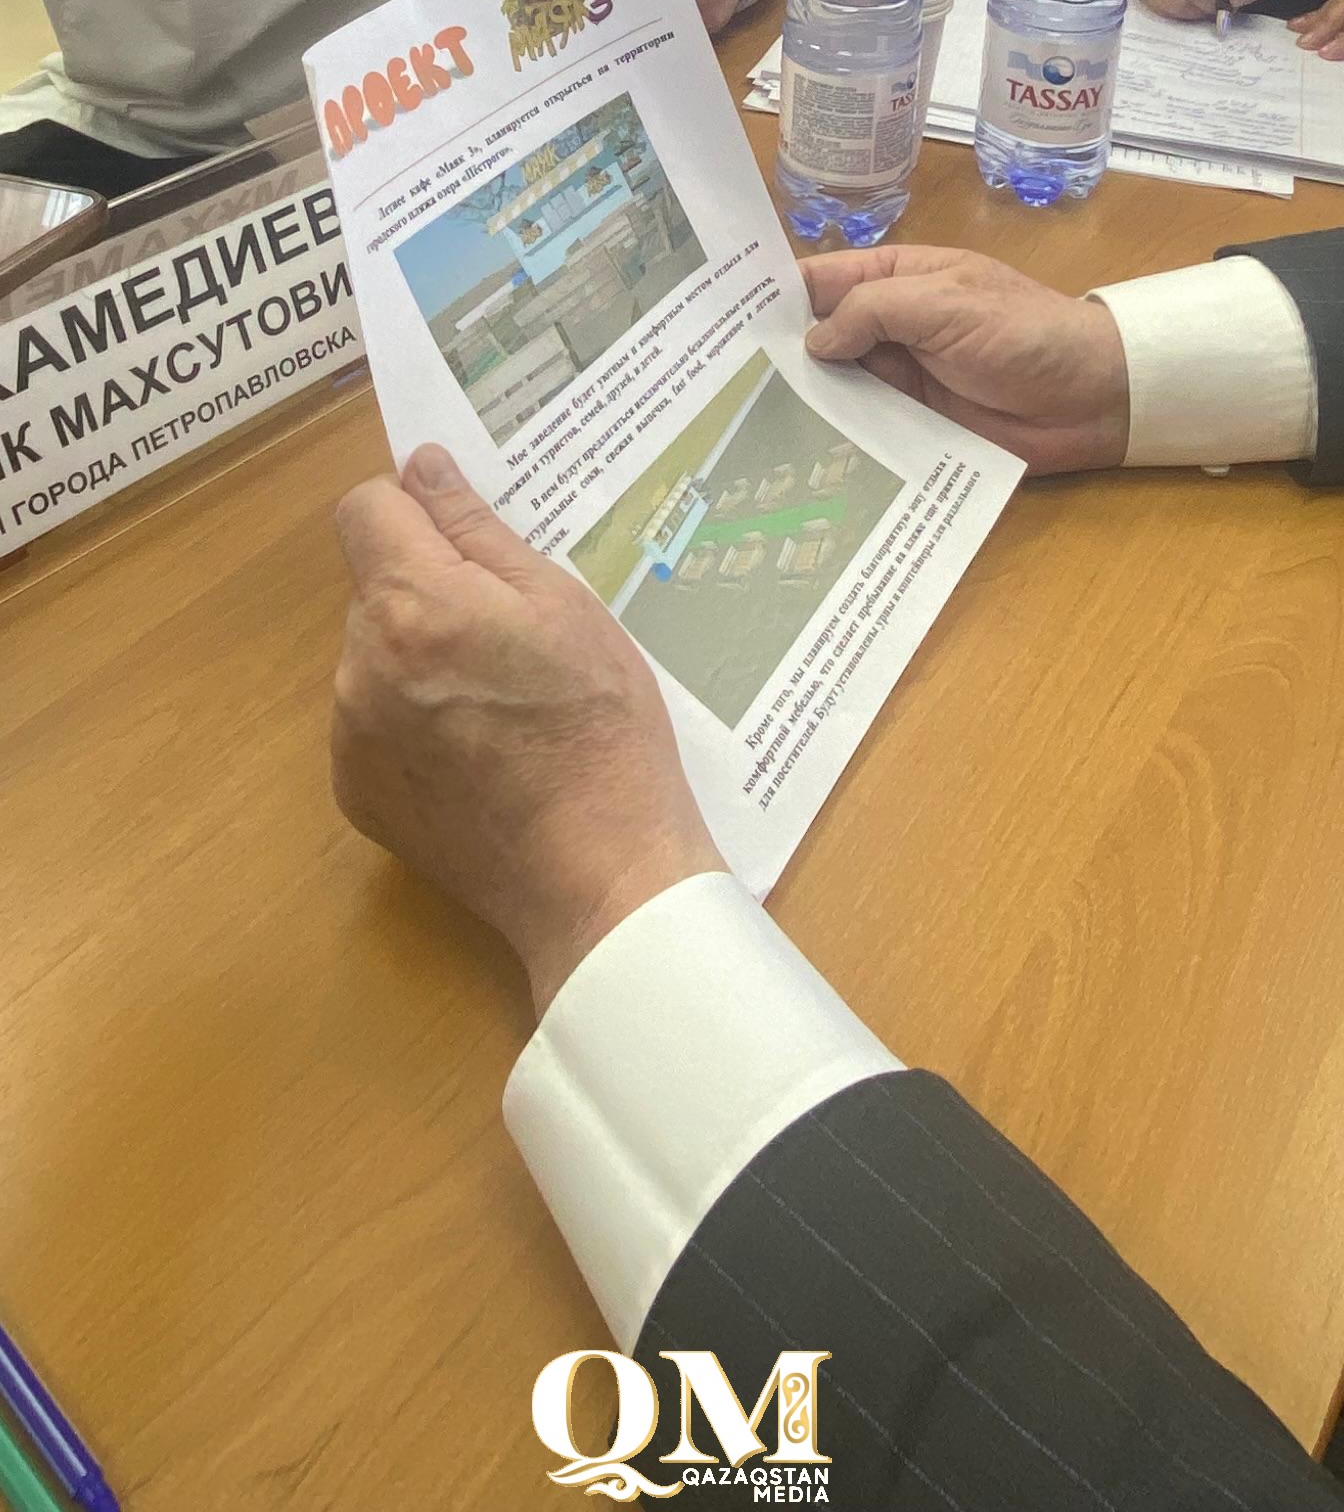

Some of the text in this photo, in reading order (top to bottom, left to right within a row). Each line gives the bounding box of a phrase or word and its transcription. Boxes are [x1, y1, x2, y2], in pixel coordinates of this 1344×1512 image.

[324, 26, 475, 158] ПРОЕКТ
[378, 195, 406, 221] Летнее
[409, 177, 432, 197] кафе
[435, 155, 465, 179] «Маяк
[484, 107, 540, 146] планируется
[544, 74, 593, 108] открыться
[597, 64, 609, 76] на
[614, 31, 675, 66] территории
[1006, 78, 1104, 111] TASSAY
[366, 215, 408, 254] городского
[407, 196, 436, 220] пляжа
[437, 180, 461, 200] озера
[11, 453, 126, 529] ГОРОДА
[131, 324, 357, 466] ПЕТРОПАВЛОВСКА
[51, 262, 354, 447] МАХСУТОВИ
[493, 471, 532, 510] горожан
[533, 463, 540, 474] и
[538, 422, 582, 466] туристов,
[634, 365, 641, 376] и
[506, 240, 760, 470] Мое заведение будет уютным и комфортным местом отдыха для
[524, 490, 578, 544] атуральные
[580, 466, 605, 489] соки,
[606, 432, 634, 464] свежая
[635, 397, 672, 433] выпечка,
[706, 320, 744, 360] мороженое
[746, 312, 753, 321] и
[755, 288, 781, 314] легкие
[530, 276, 775, 511] В нем будут предлагаться исключительно безалкогольные напитки,
[541, 528, 570, 556] уски.
[742, 462, 967, 794] комфортной мебелью, что сделает пребывание на пляже еще приятнее
[744, 452, 953, 751] Кроме того, мы планируем создать благоприятную зону отдыха с
[758, 471, 980, 813] для посетителей. Будут установлены урны и контейнеры для раздельного
